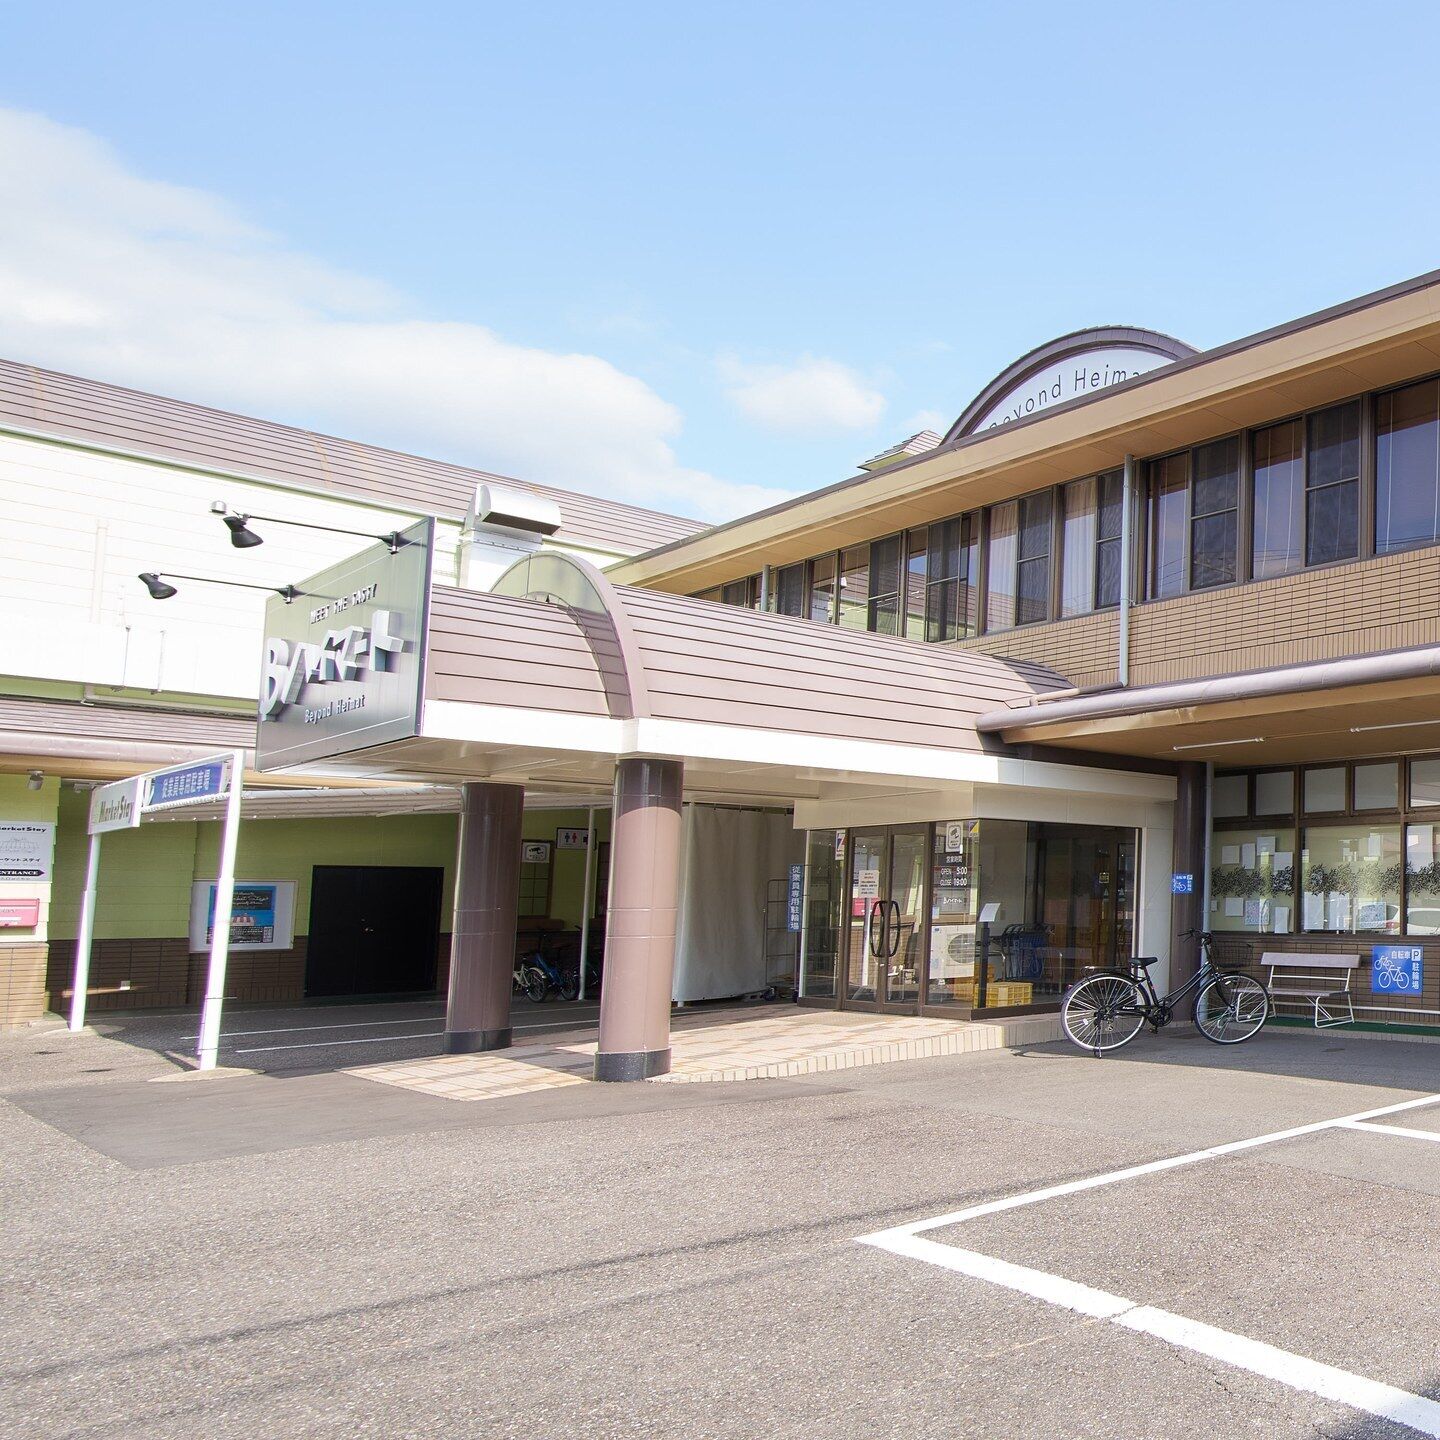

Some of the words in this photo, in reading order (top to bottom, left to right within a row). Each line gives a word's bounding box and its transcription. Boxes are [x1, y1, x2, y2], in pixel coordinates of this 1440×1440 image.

[989, 375, 1061, 429] yond
[1074, 364, 1150, 391] Heim
[311, 605, 330, 624] MEET
[334, 596, 348, 614] THE
[352, 583, 377, 606] TASTY
[305, 702, 333, 724] Beyond
[336, 694, 366, 715] Heimat
[1391, 950, 1411, 959] 自転車
[1412, 962, 1420, 989] 駐輪場
